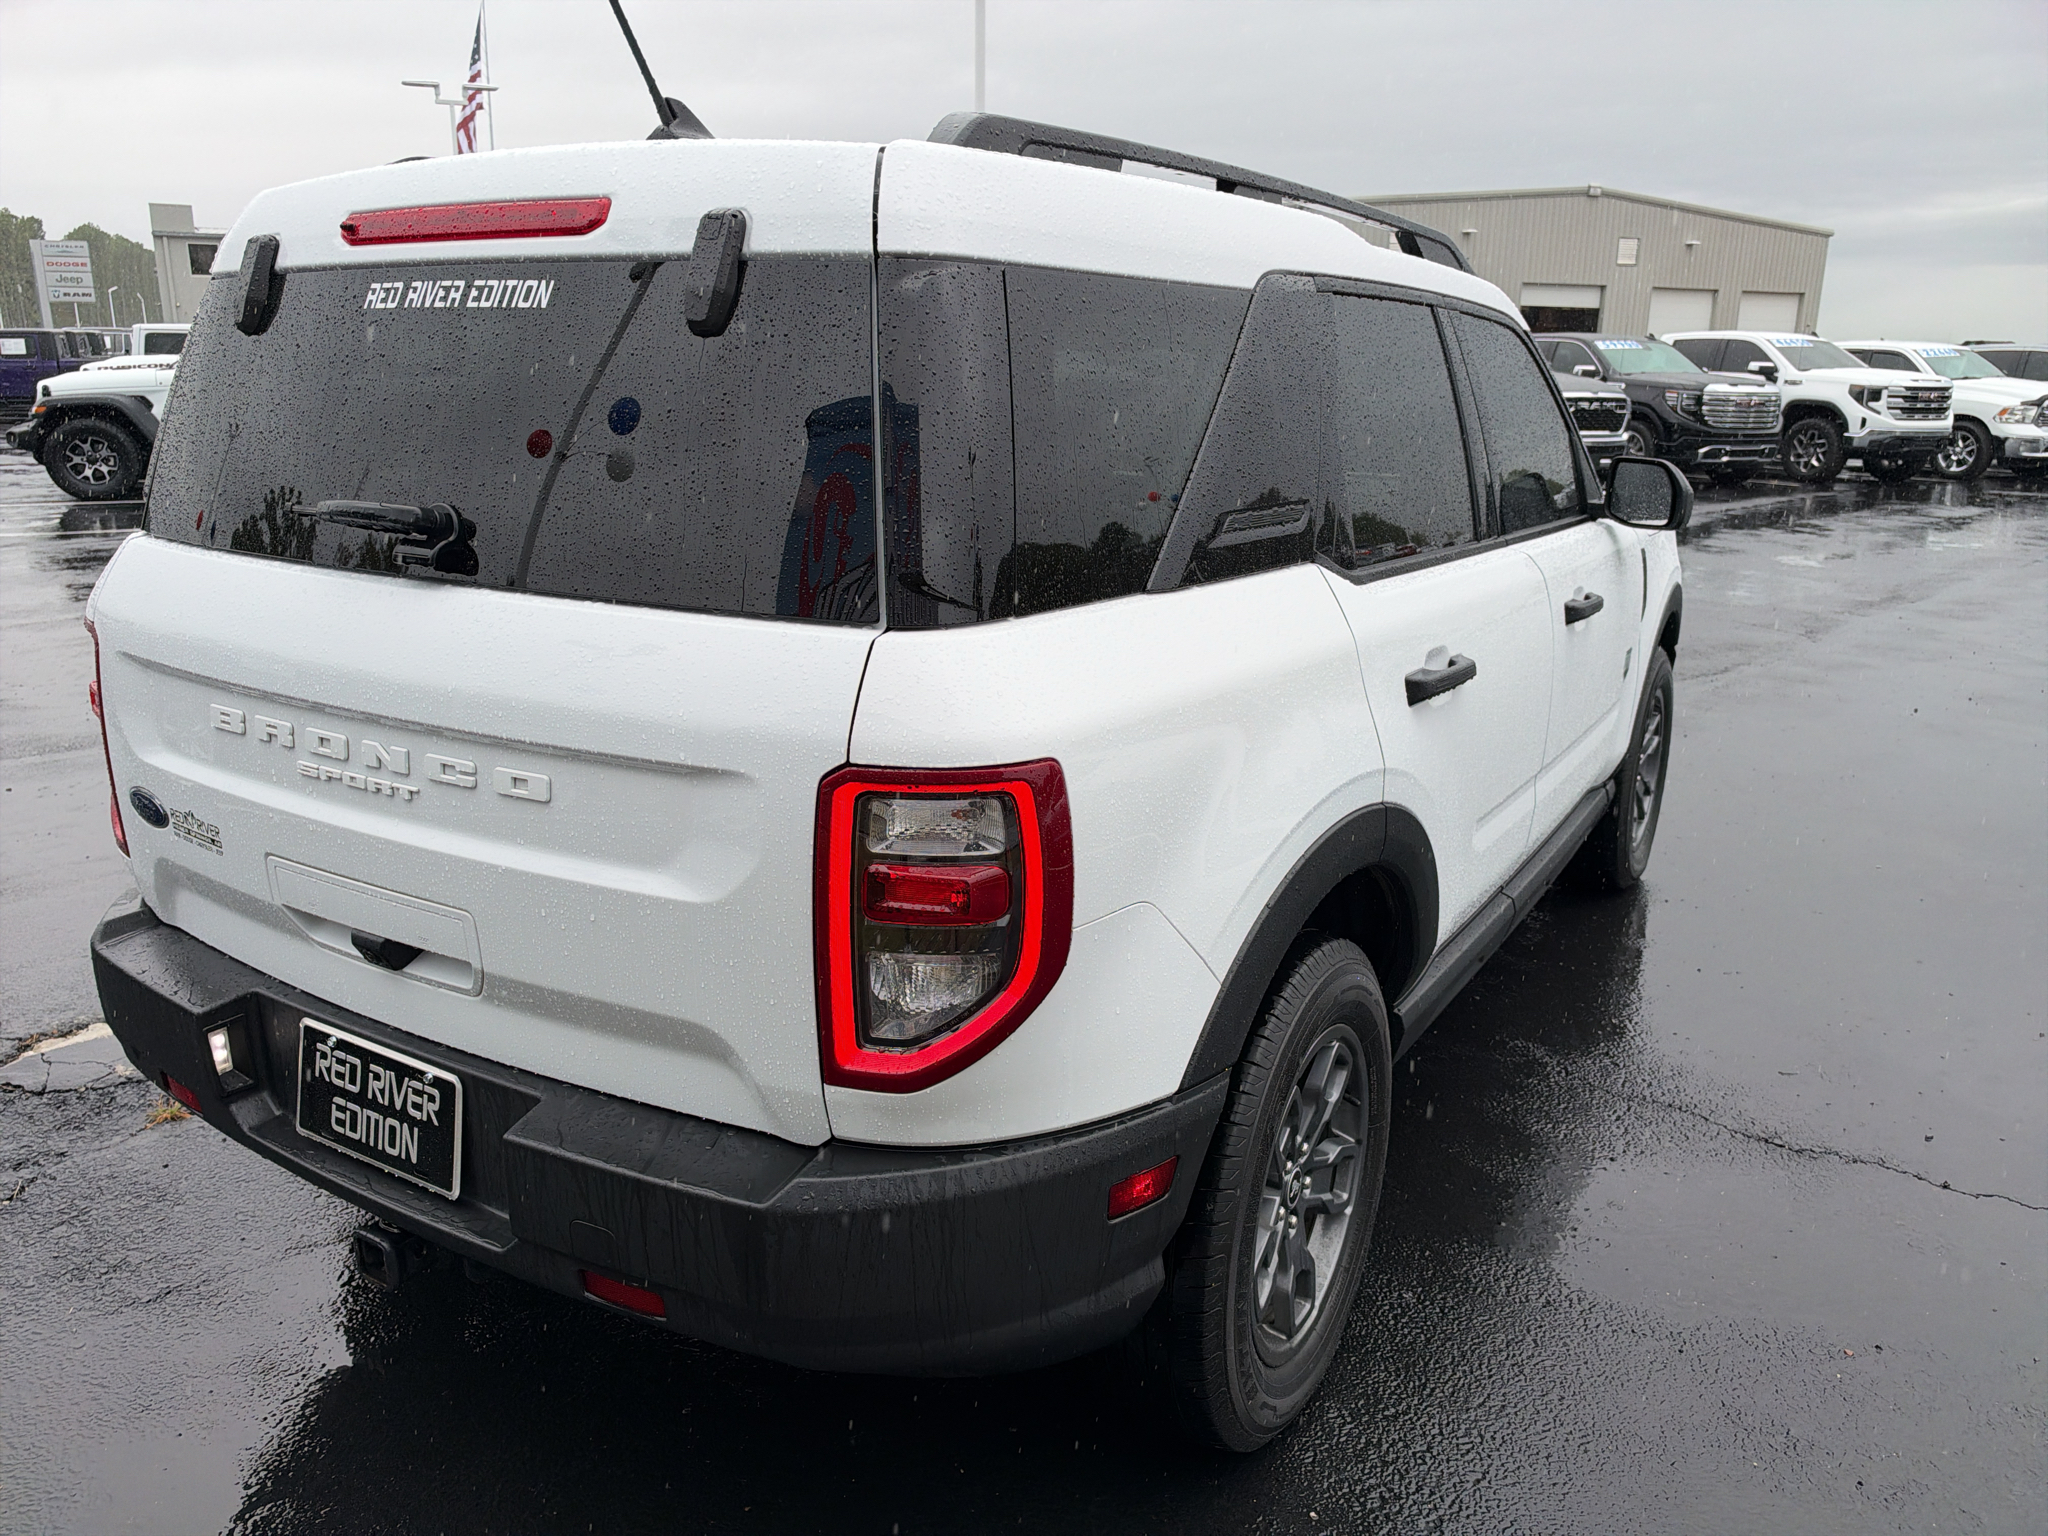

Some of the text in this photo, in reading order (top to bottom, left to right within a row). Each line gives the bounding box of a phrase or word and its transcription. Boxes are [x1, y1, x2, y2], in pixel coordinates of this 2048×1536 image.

[56, 274, 83, 285] Jeep
[363, 279, 554, 309] RED RIVER EDITION
[97, 363, 171, 371] RUBICON
[210, 703, 551, 803] BRONCO
[297, 760, 419, 801] SPORT
[315, 1042, 440, 1127] RED RIVER
[330, 1096, 419, 1164] EDITION
